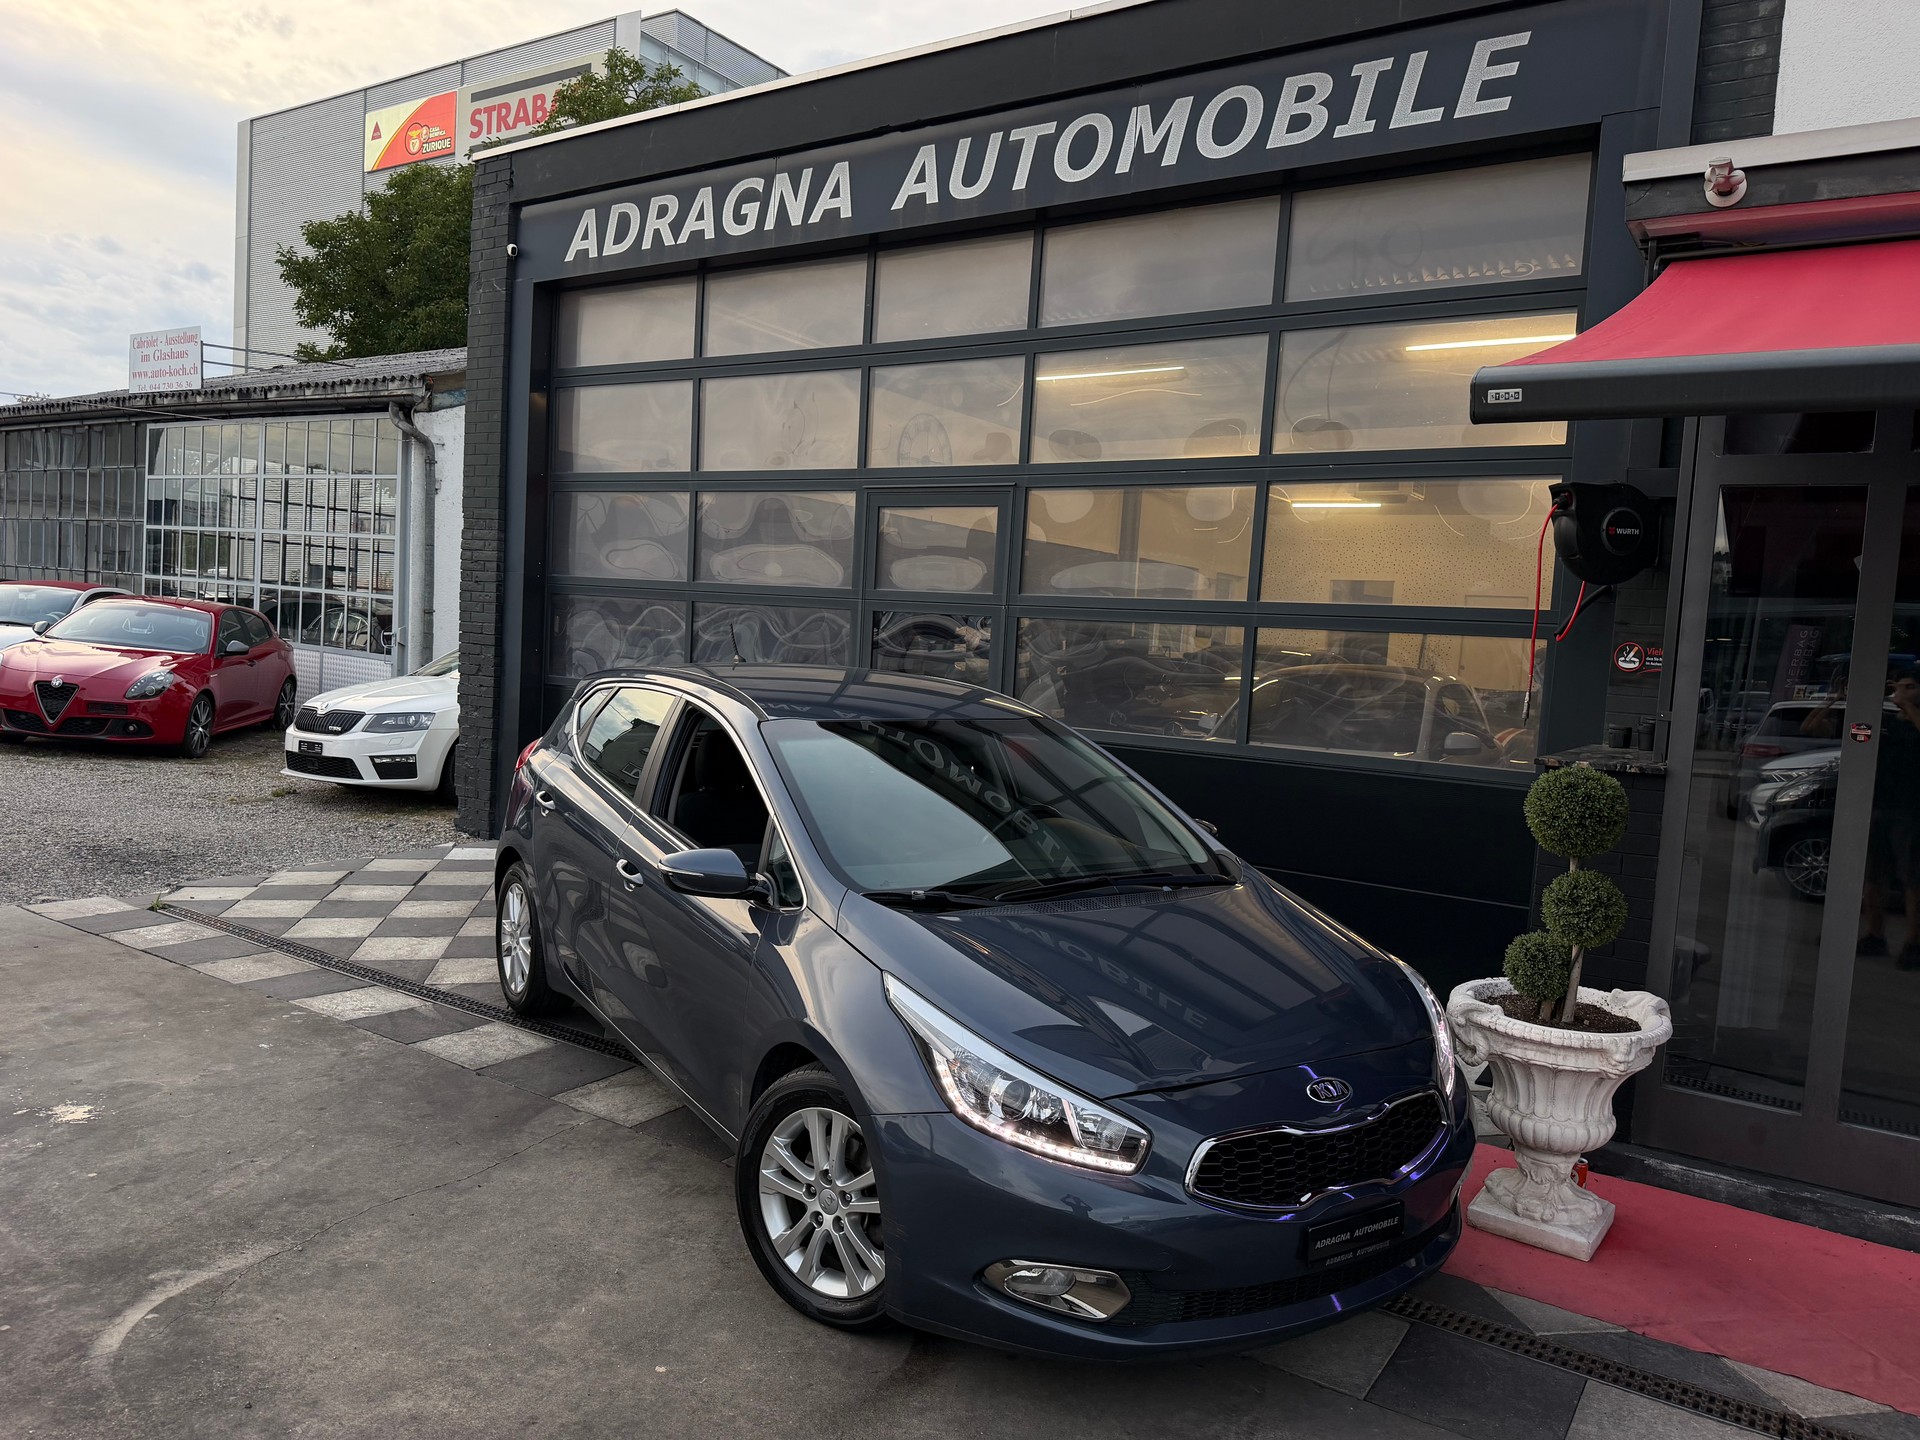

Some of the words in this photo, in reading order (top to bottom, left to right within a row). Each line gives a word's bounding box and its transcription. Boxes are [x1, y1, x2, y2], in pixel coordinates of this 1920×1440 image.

[469, 89, 561, 138] STRAB
[423, 138, 452, 153] ZURIQUE
[564, 161, 852, 262] ADRAGNA
[891, 31, 1532, 210] AUTOMOBILE
[133, 336, 158, 349] Cabriolet
[165, 332, 198, 346] Ausstellung
[141, 351, 150, 362] im
[153, 348, 188, 361] Glashaus
[132, 363, 198, 380] www.auto-koch.ch
[1311, 1080, 1349, 1100] KIA
[1315, 1232, 1350, 1249] ADRAGNA
[1354, 1216, 1399, 1237] AUTOMOBILE
[1326, 1252, 1353, 1266] ADRAGNA
